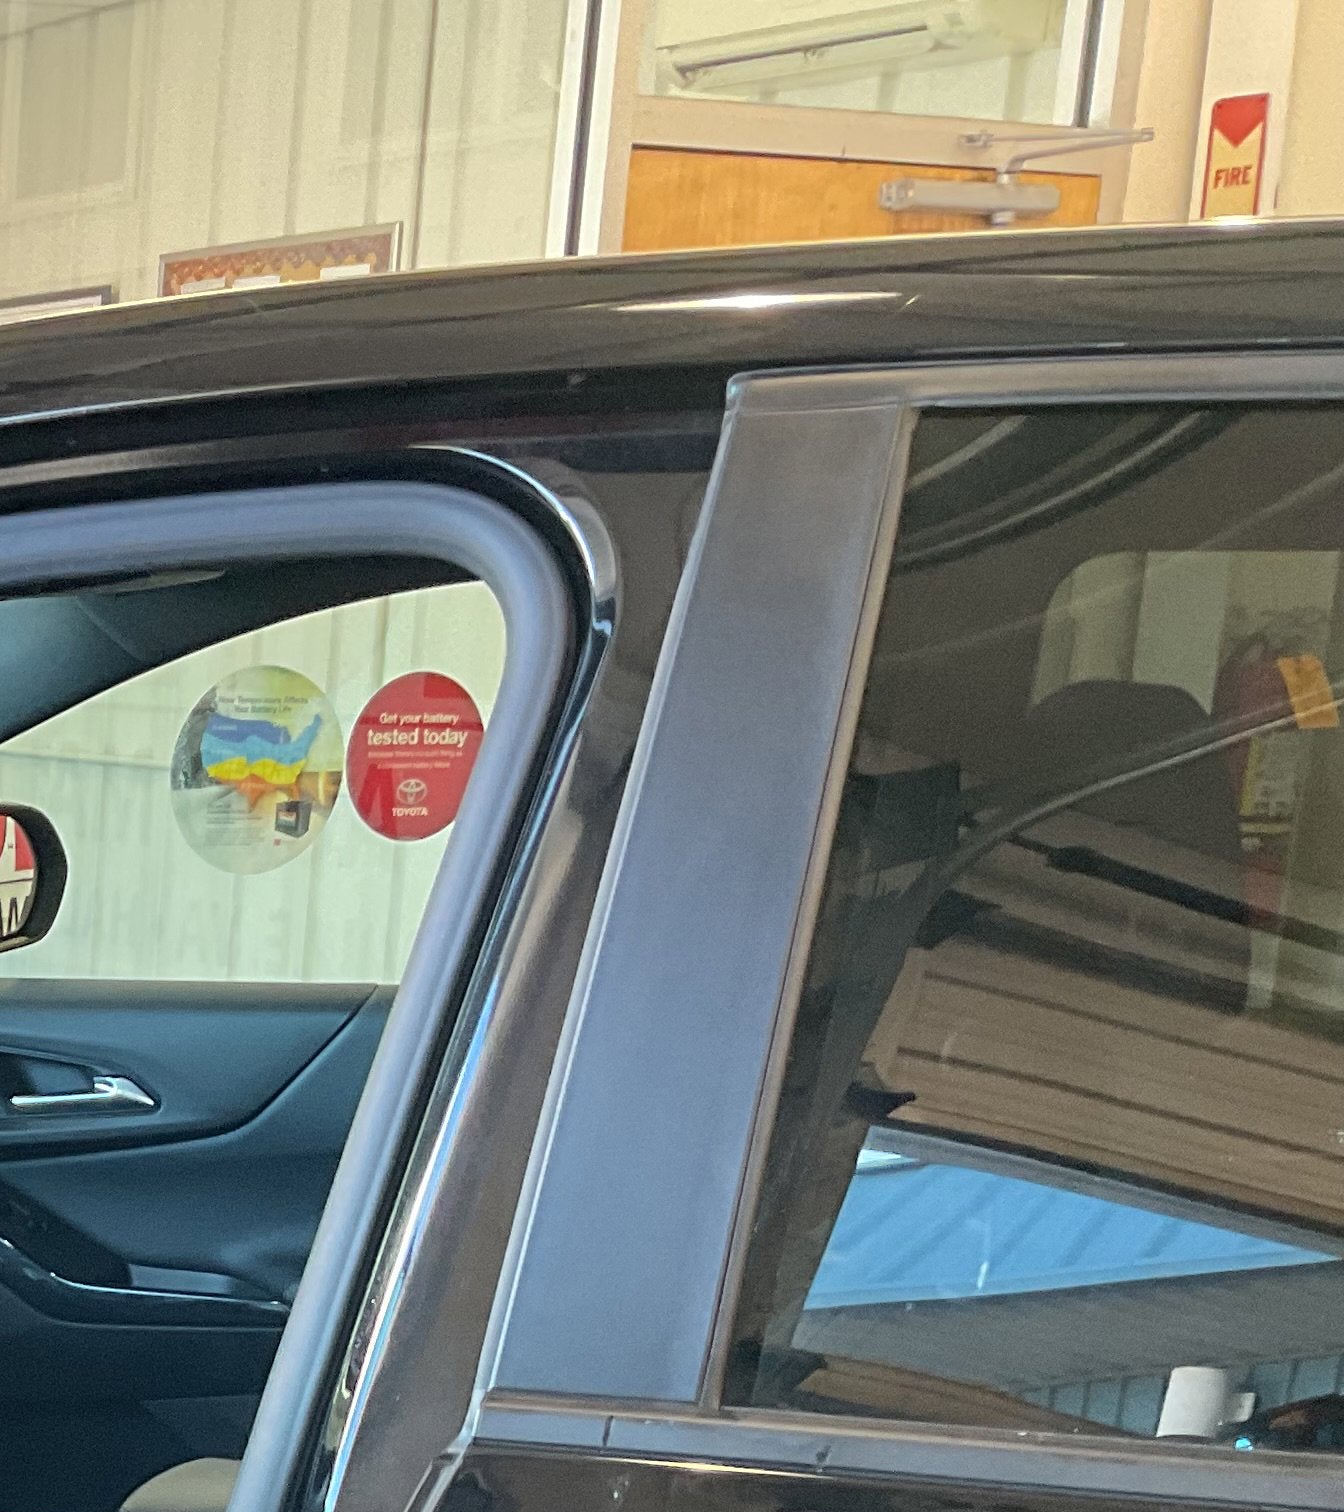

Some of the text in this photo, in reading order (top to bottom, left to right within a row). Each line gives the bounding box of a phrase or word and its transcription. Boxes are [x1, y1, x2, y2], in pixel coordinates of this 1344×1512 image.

[1213, 165, 1253, 189] FIRE
[379, 712, 460, 726] Get your battery
[367, 727, 468, 748] tested today
[391, 807, 428, 817] TOYOTA
